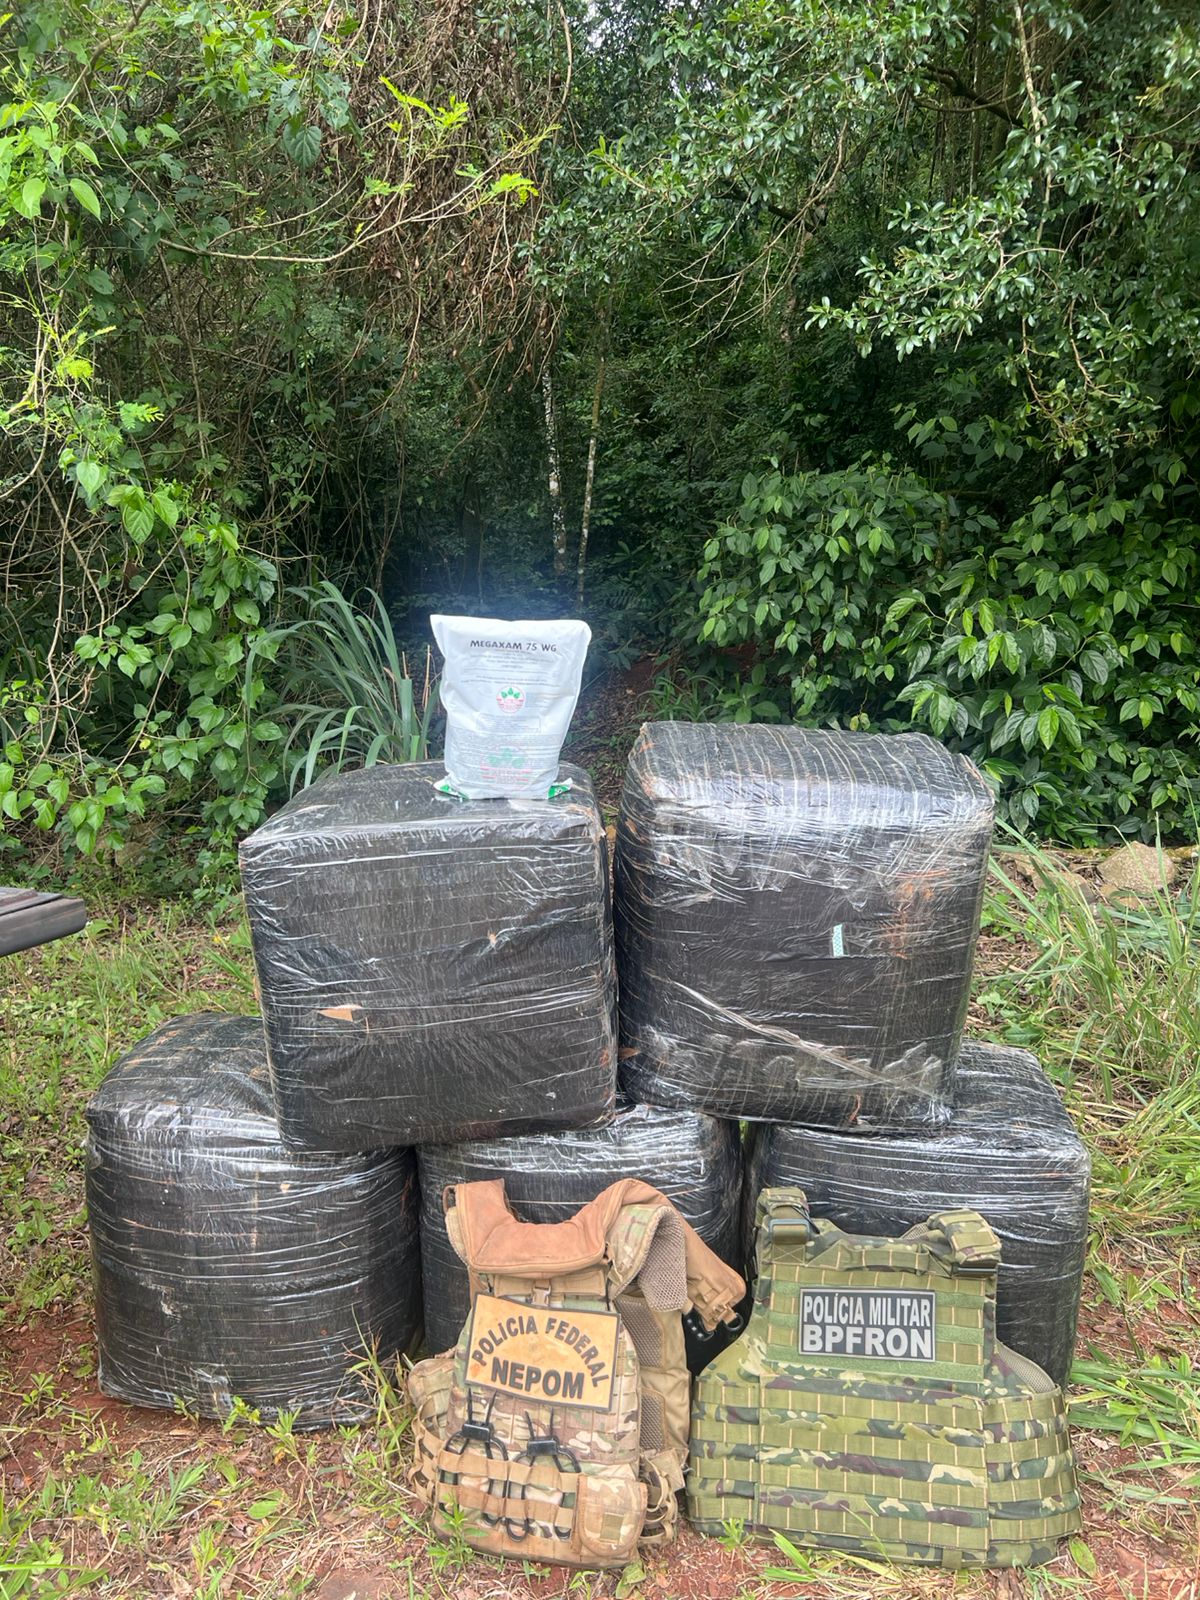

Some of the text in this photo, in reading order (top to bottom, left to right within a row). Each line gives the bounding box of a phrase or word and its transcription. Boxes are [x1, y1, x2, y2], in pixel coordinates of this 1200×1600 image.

[470, 640, 522, 650] MEGAXAM
[526, 642, 538, 651] 75
[541, 644, 557, 652] WG
[804, 1293, 931, 1327] POLÍCIA MILITAR
[545, 1317, 609, 1387] FEDERAL
[803, 1324, 932, 1358] BPFRON
[491, 1357, 585, 1399] NEPOM
